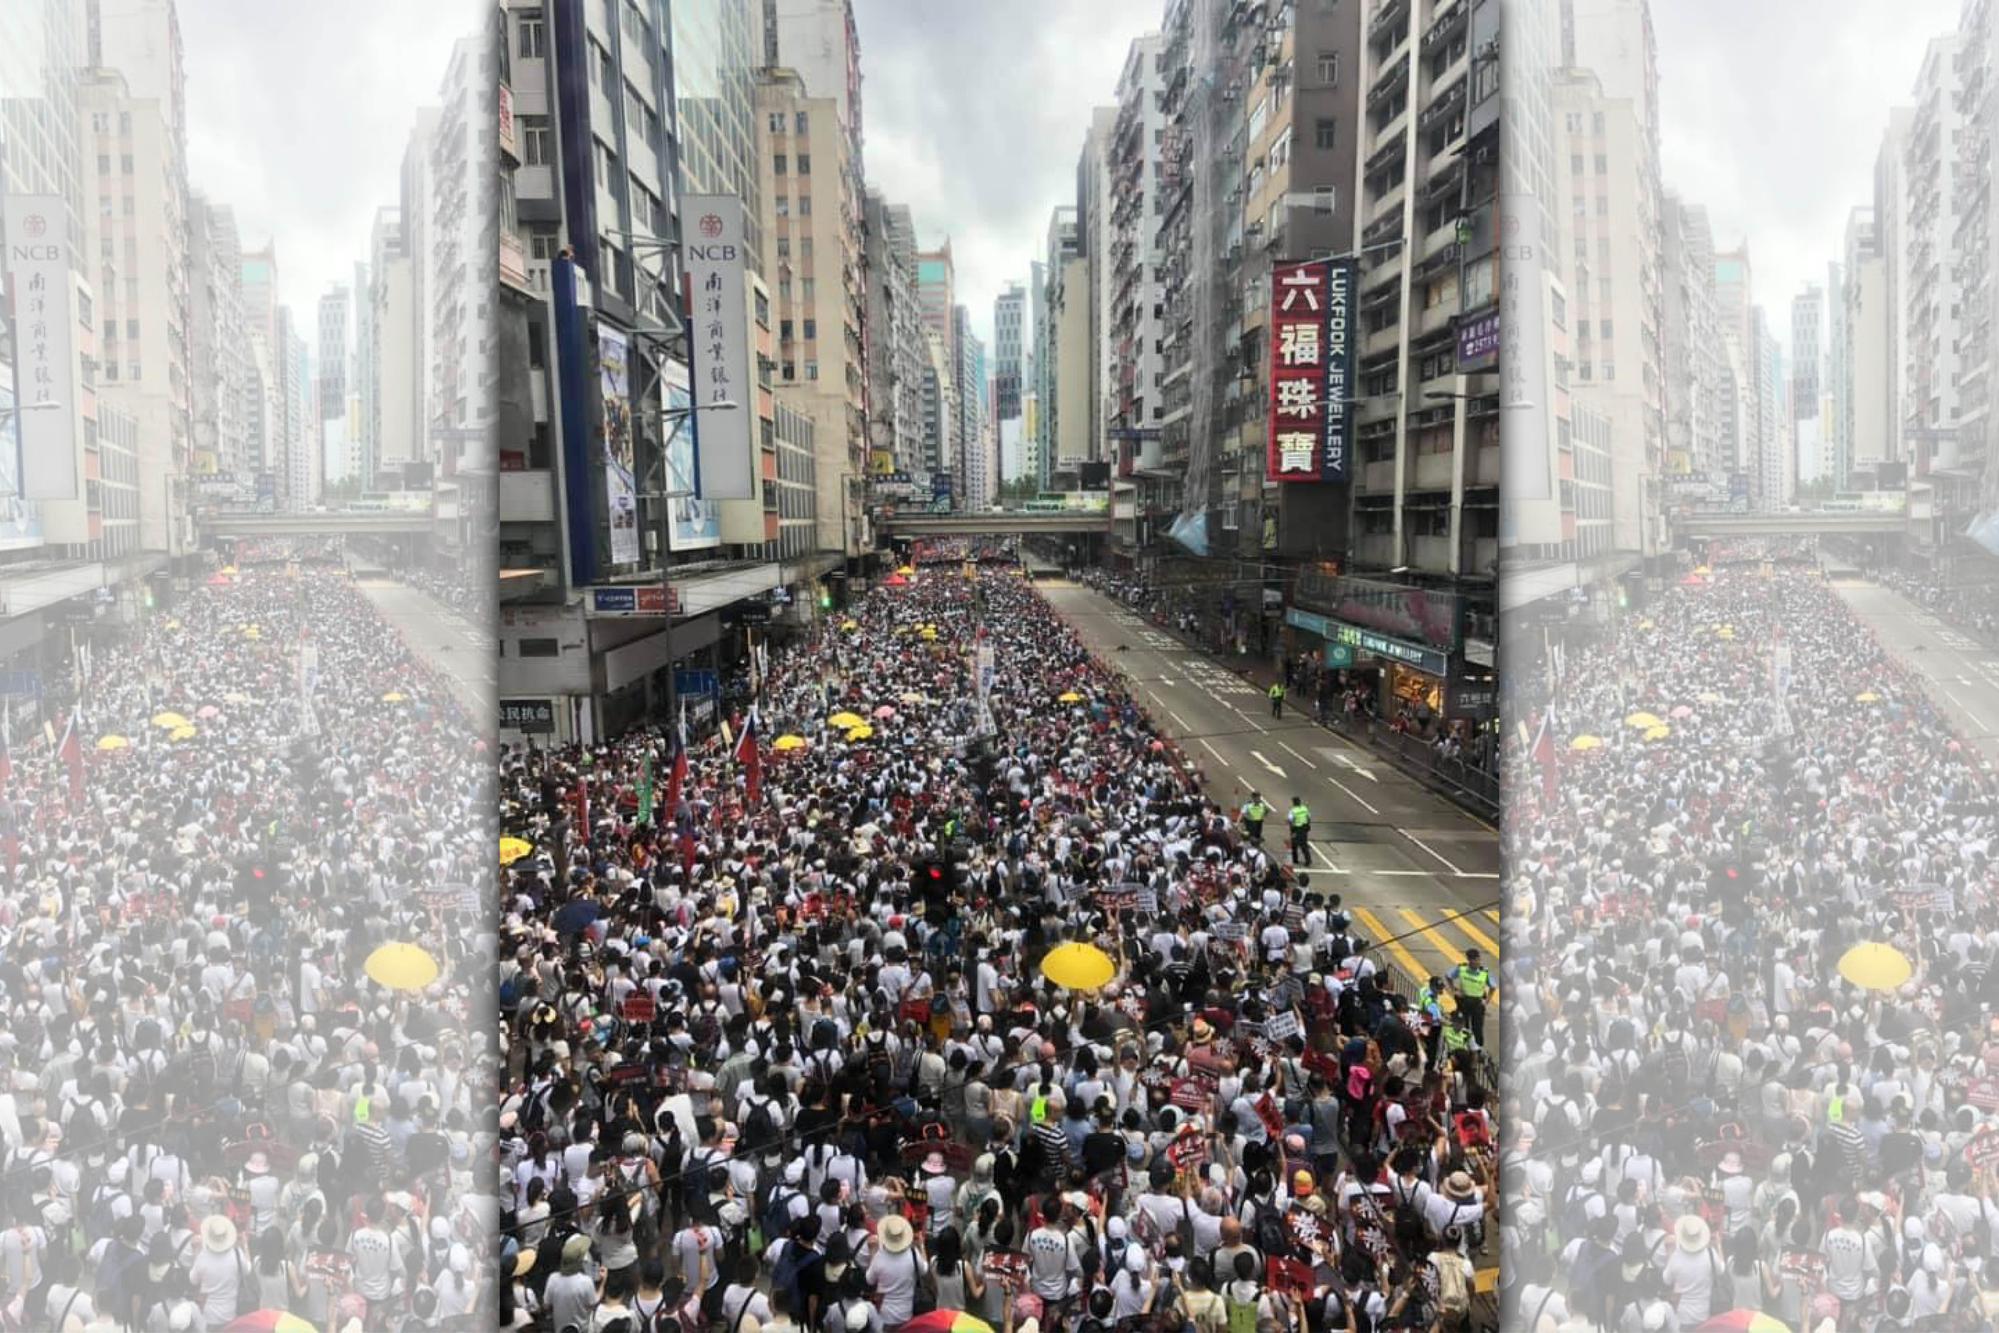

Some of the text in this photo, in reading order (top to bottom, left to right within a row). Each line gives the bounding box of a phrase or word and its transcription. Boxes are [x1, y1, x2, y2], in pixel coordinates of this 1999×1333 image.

[13, 246, 59, 262] NCB
[689, 246, 736, 262] NCB
[1278, 269, 1319, 472] 六福珠寶
[1326, 268, 1346, 470] LUKFOOK JEWELLERY
